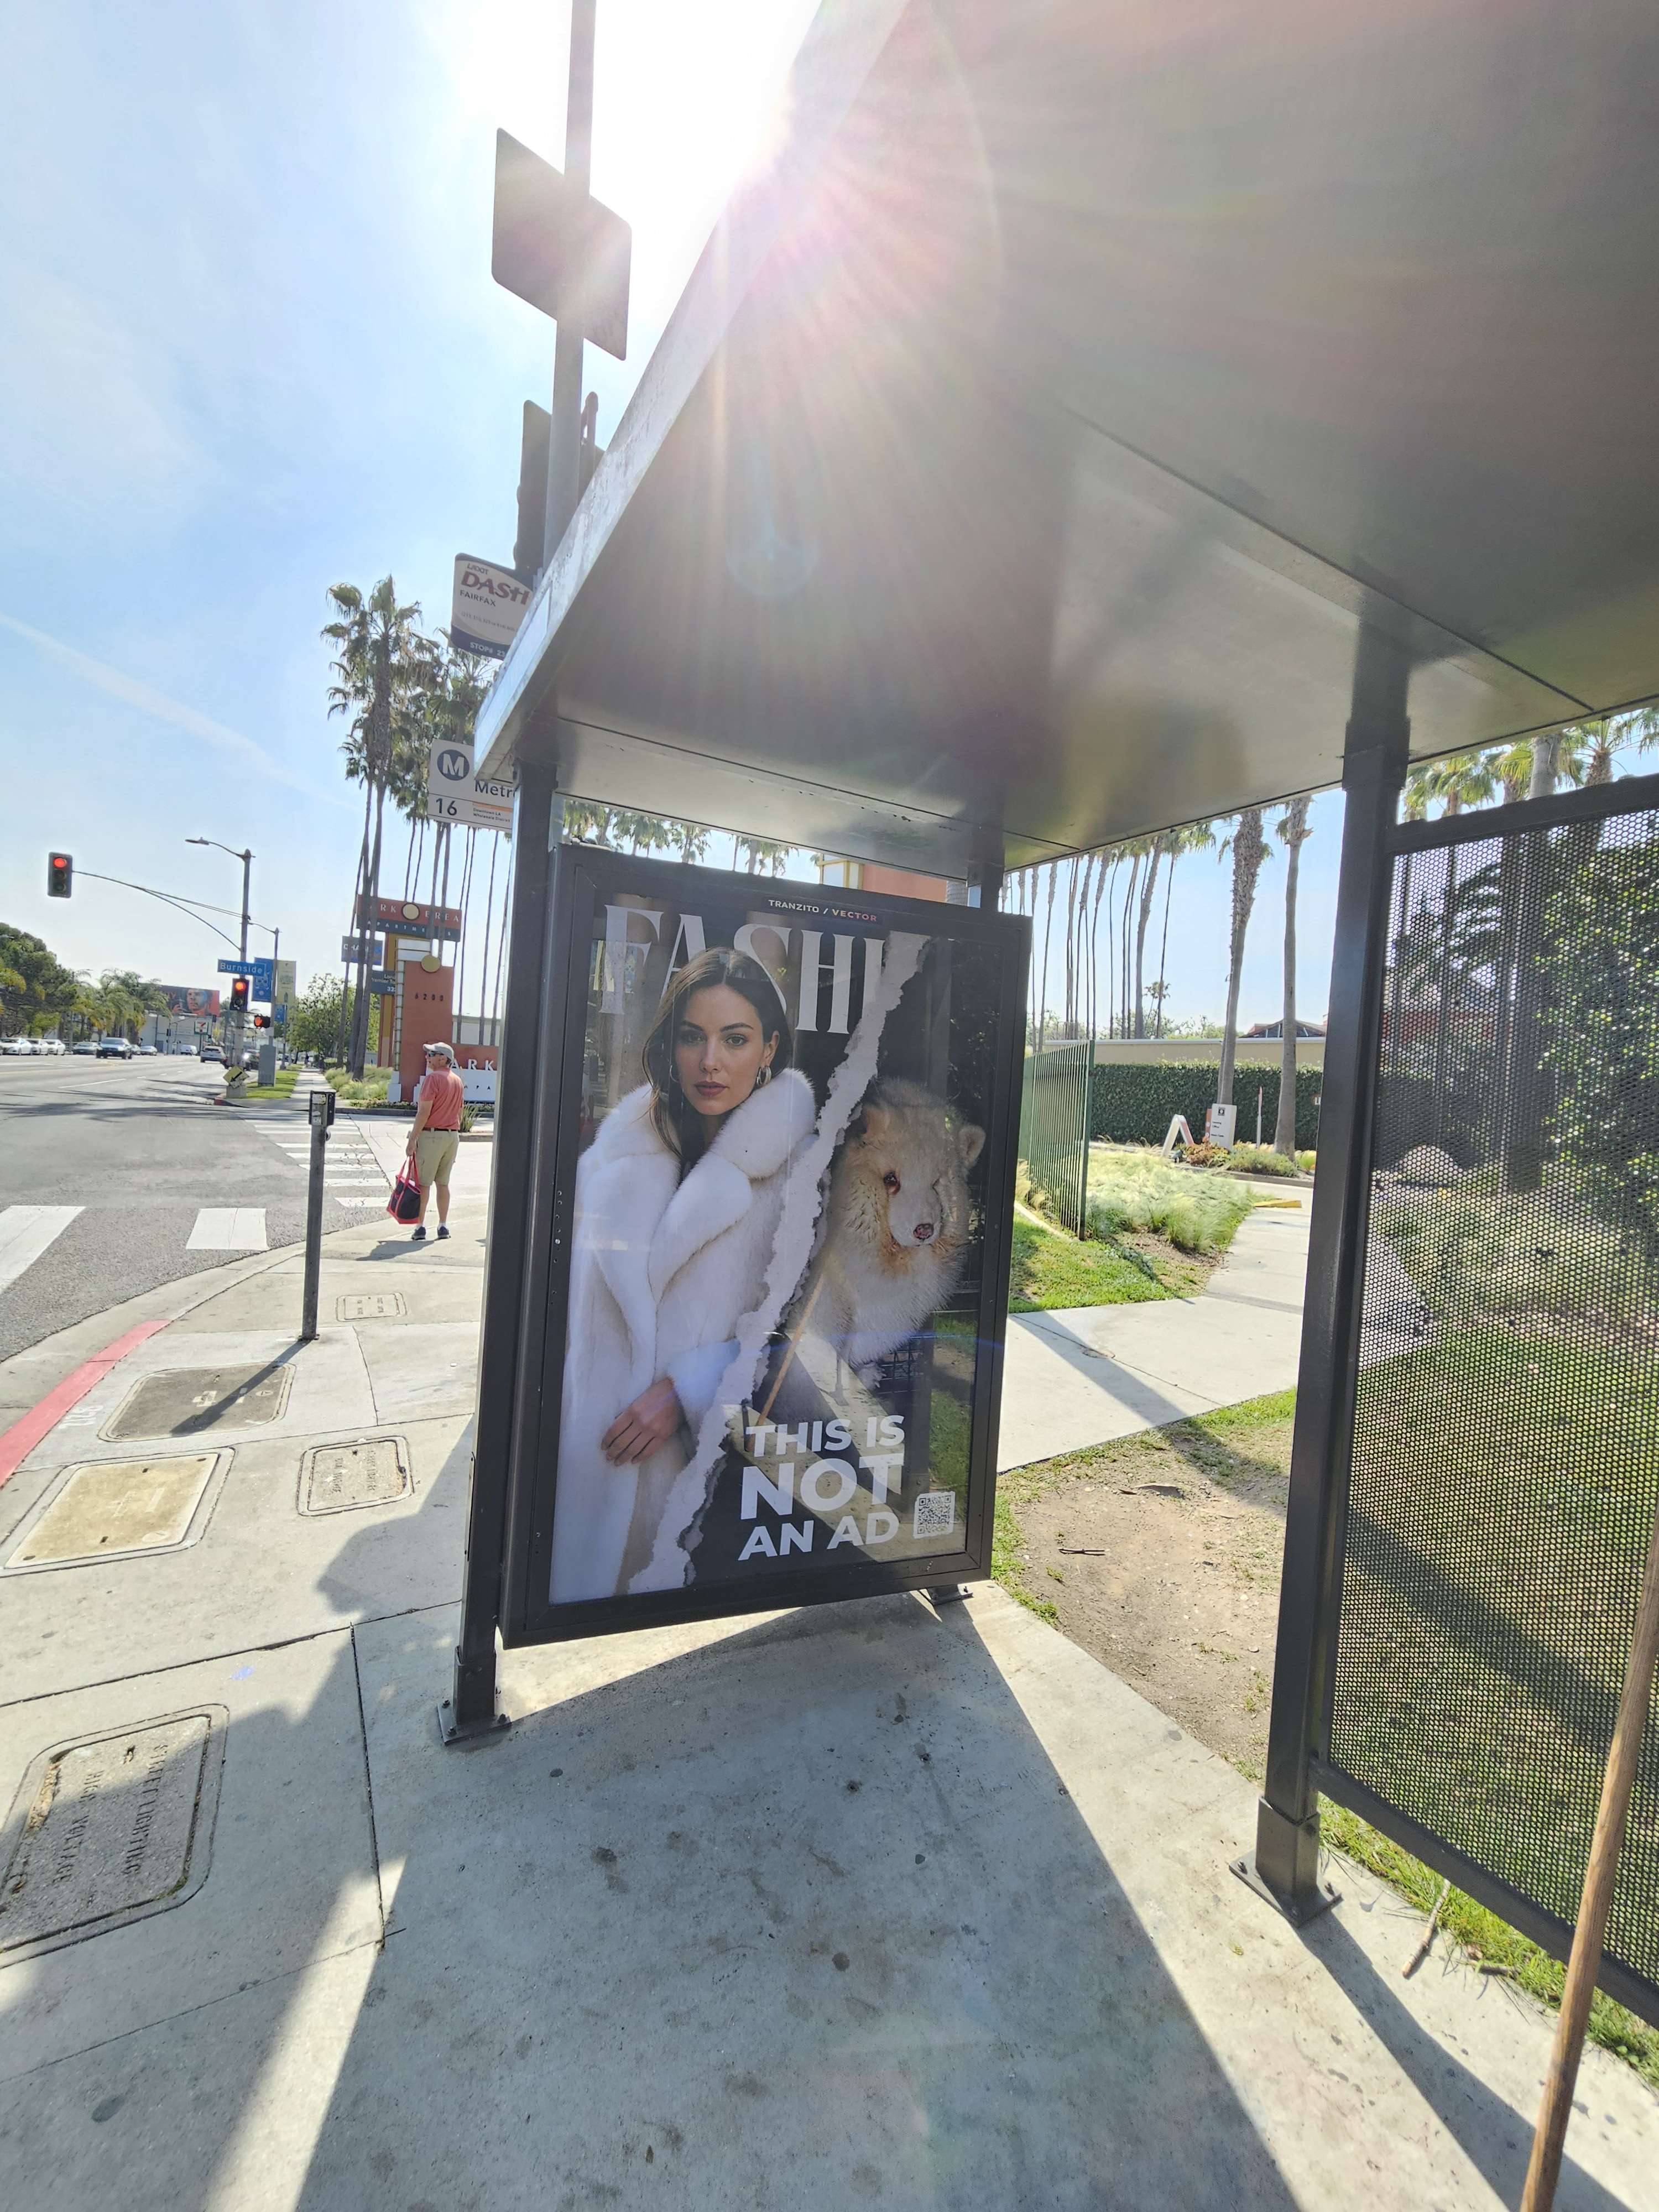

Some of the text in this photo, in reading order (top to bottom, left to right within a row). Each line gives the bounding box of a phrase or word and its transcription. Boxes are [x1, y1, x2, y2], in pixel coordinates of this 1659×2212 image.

[460, 589, 496, 607] FAIRFAX
[461, 571, 530, 605] DASH
[435, 797, 458, 816] 16
[768, 899, 820, 912] TRANZITO
[832, 909, 877, 921] VECTOR
[221, 962, 263, 974] Burnside
[745, 1415, 905, 1458] THIS IS
[740, 1453, 905, 1520] NOT
[738, 1511, 900, 1561] AN AD
